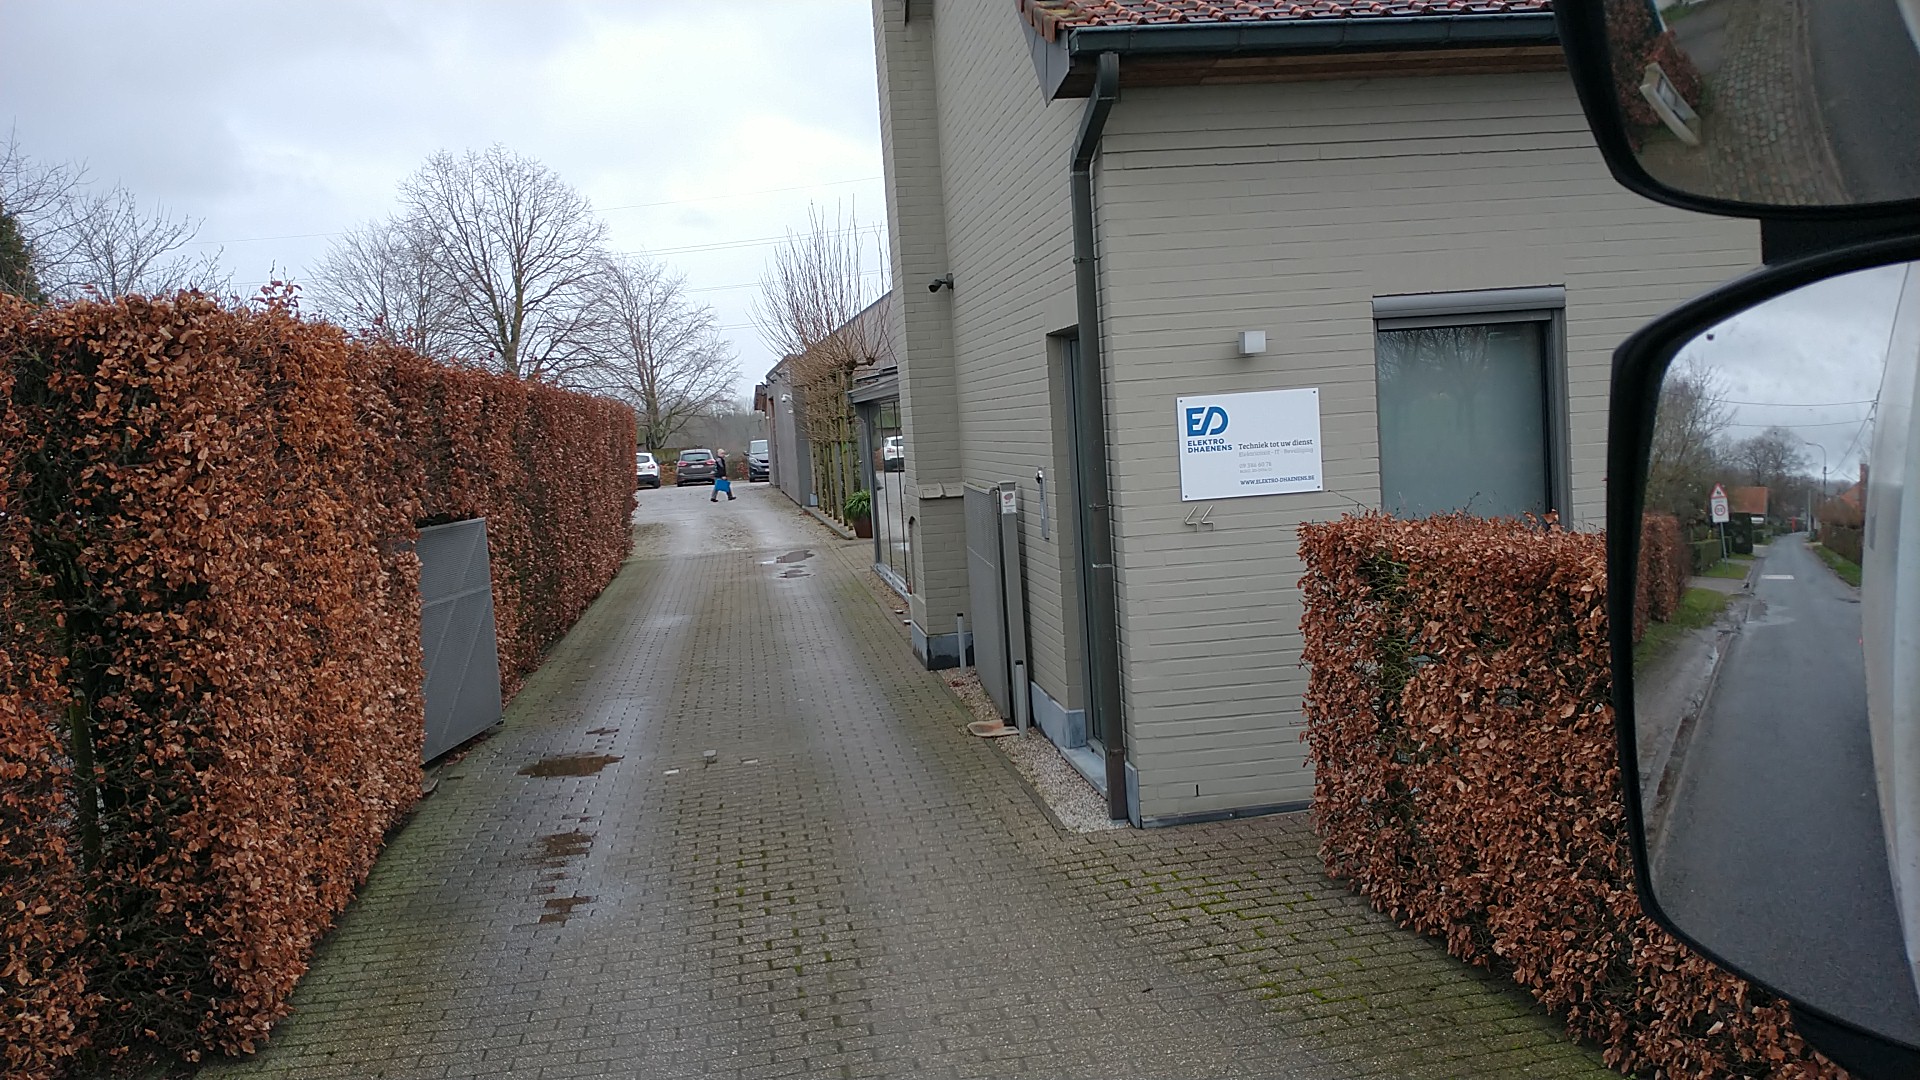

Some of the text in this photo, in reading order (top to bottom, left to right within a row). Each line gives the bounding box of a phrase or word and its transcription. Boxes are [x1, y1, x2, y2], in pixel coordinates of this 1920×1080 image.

[1186, 406, 1229, 437] ED
[1187, 438, 1225, 447] ELEKTRO
[1238, 442, 1269, 450] Techniek
[1292, 439, 1313, 447] dienst
[1187, 445, 1233, 454] DHAENENS
[1240, 475, 1315, 485] WWW.ELEKTRO-DHAENENS.BE
